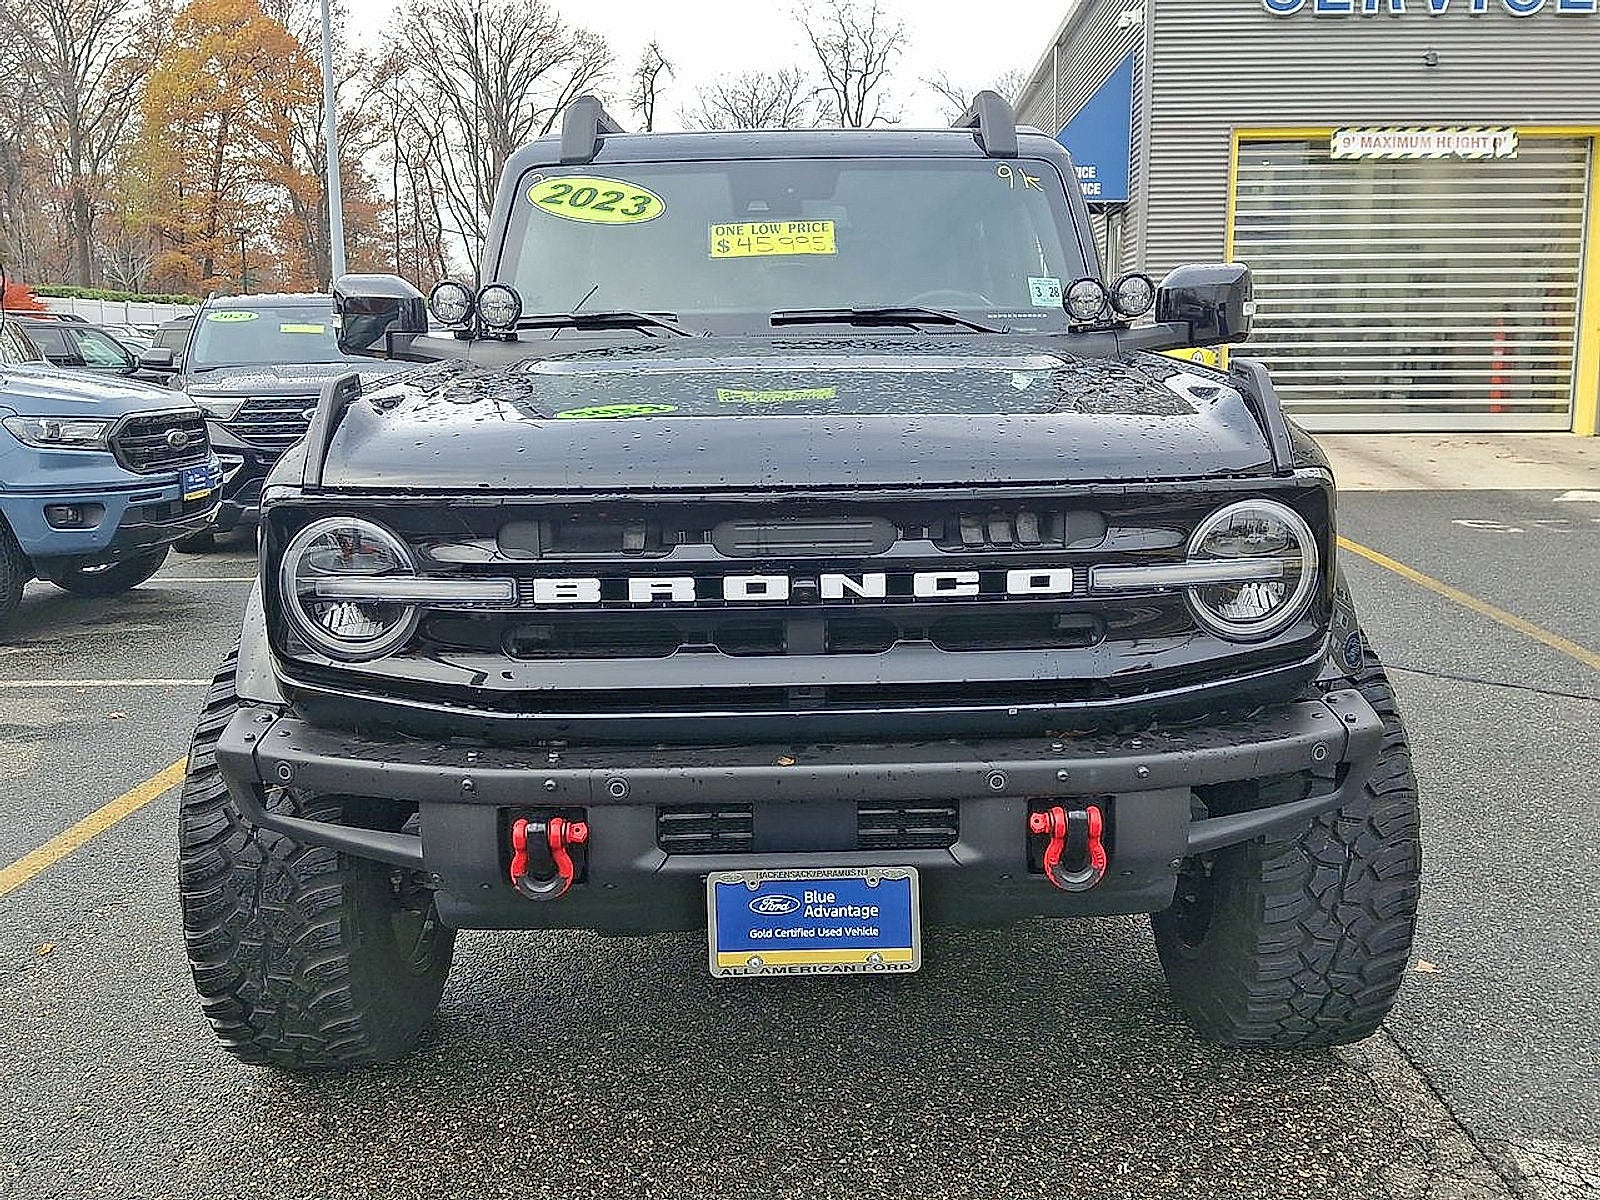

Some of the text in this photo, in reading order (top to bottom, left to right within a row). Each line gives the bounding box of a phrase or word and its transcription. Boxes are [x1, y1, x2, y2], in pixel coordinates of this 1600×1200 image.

[1361, 137, 1432, 149] MAXIMUM
[540, 183, 652, 216] 2023
[715, 222, 830, 236] ONE LOW PRICE
[1048, 286, 1060, 298] 28
[533, 568, 1074, 604] BRONCO
[804, 890, 836, 904] Blue
[803, 904, 879, 919] Advantage
[749, 925, 879, 939] Gold Certified Used Vehicle
[720, 963, 913, 976] ALL AMERICAN FORD
